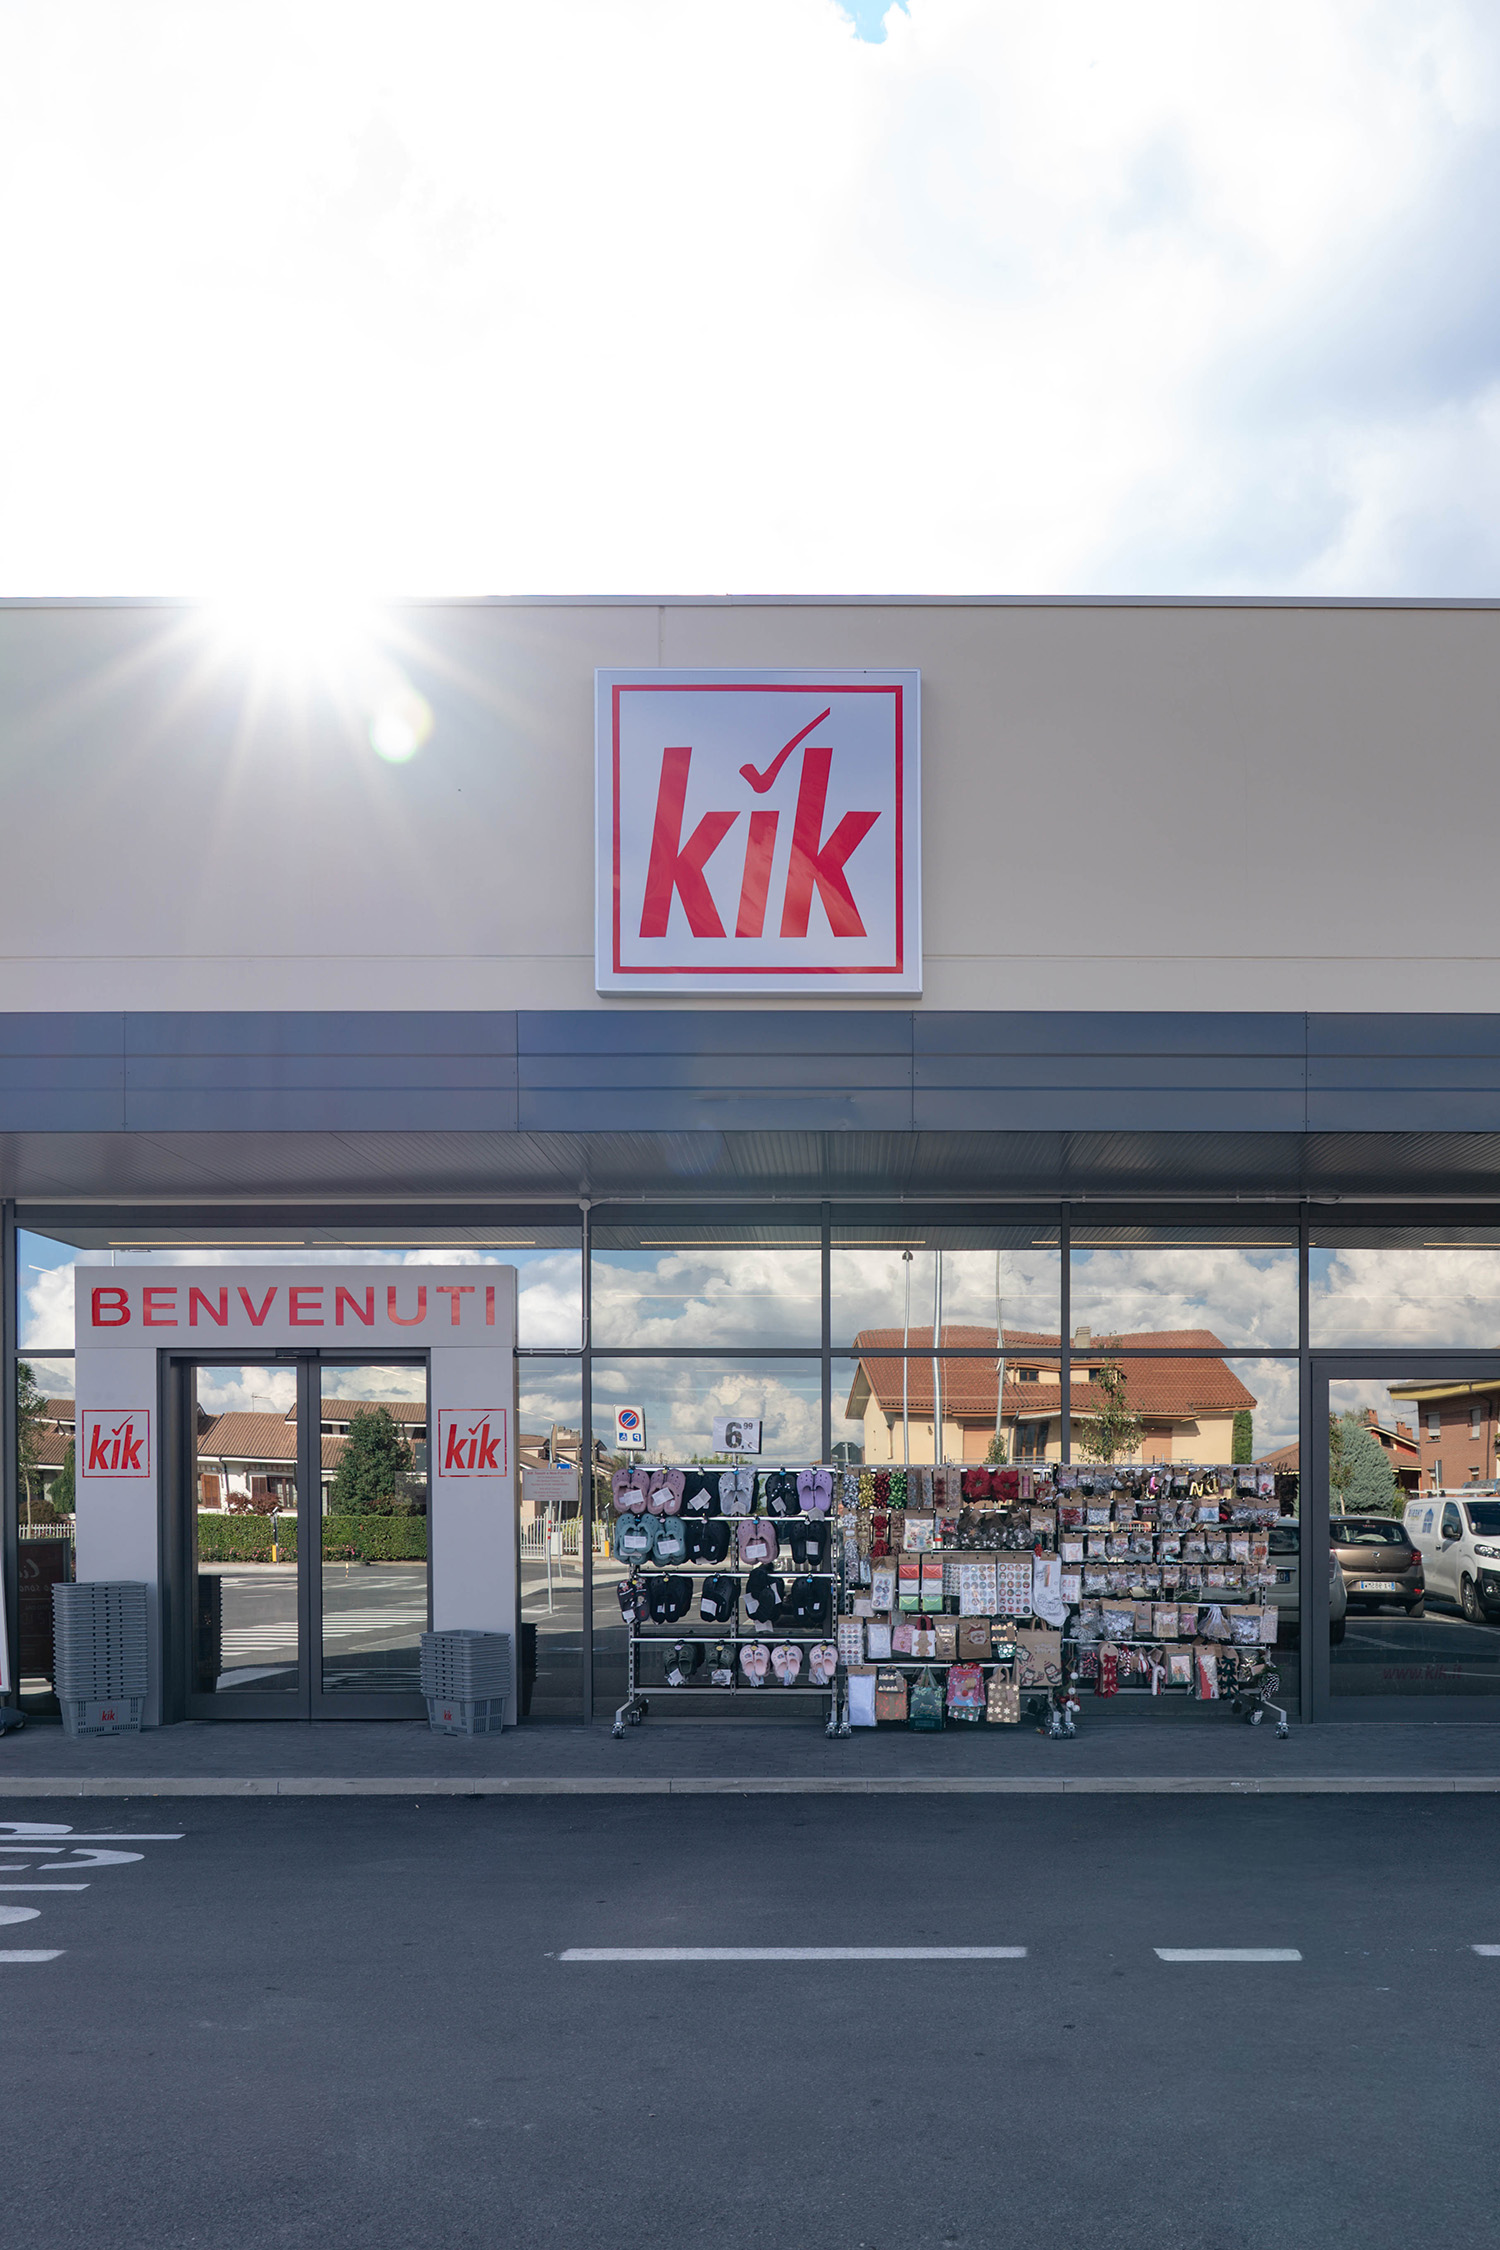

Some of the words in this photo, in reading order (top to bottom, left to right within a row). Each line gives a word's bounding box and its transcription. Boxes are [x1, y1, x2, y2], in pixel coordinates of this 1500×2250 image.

[639, 707, 882, 938] kik
[91, 1285, 496, 1327] BENVENUTI
[88, 1415, 145, 1469] kik
[445, 1414, 502, 1469] kik
[1383, 1664, 1463, 1680] www.kik.it
[102, 1709, 115, 1721] kik
